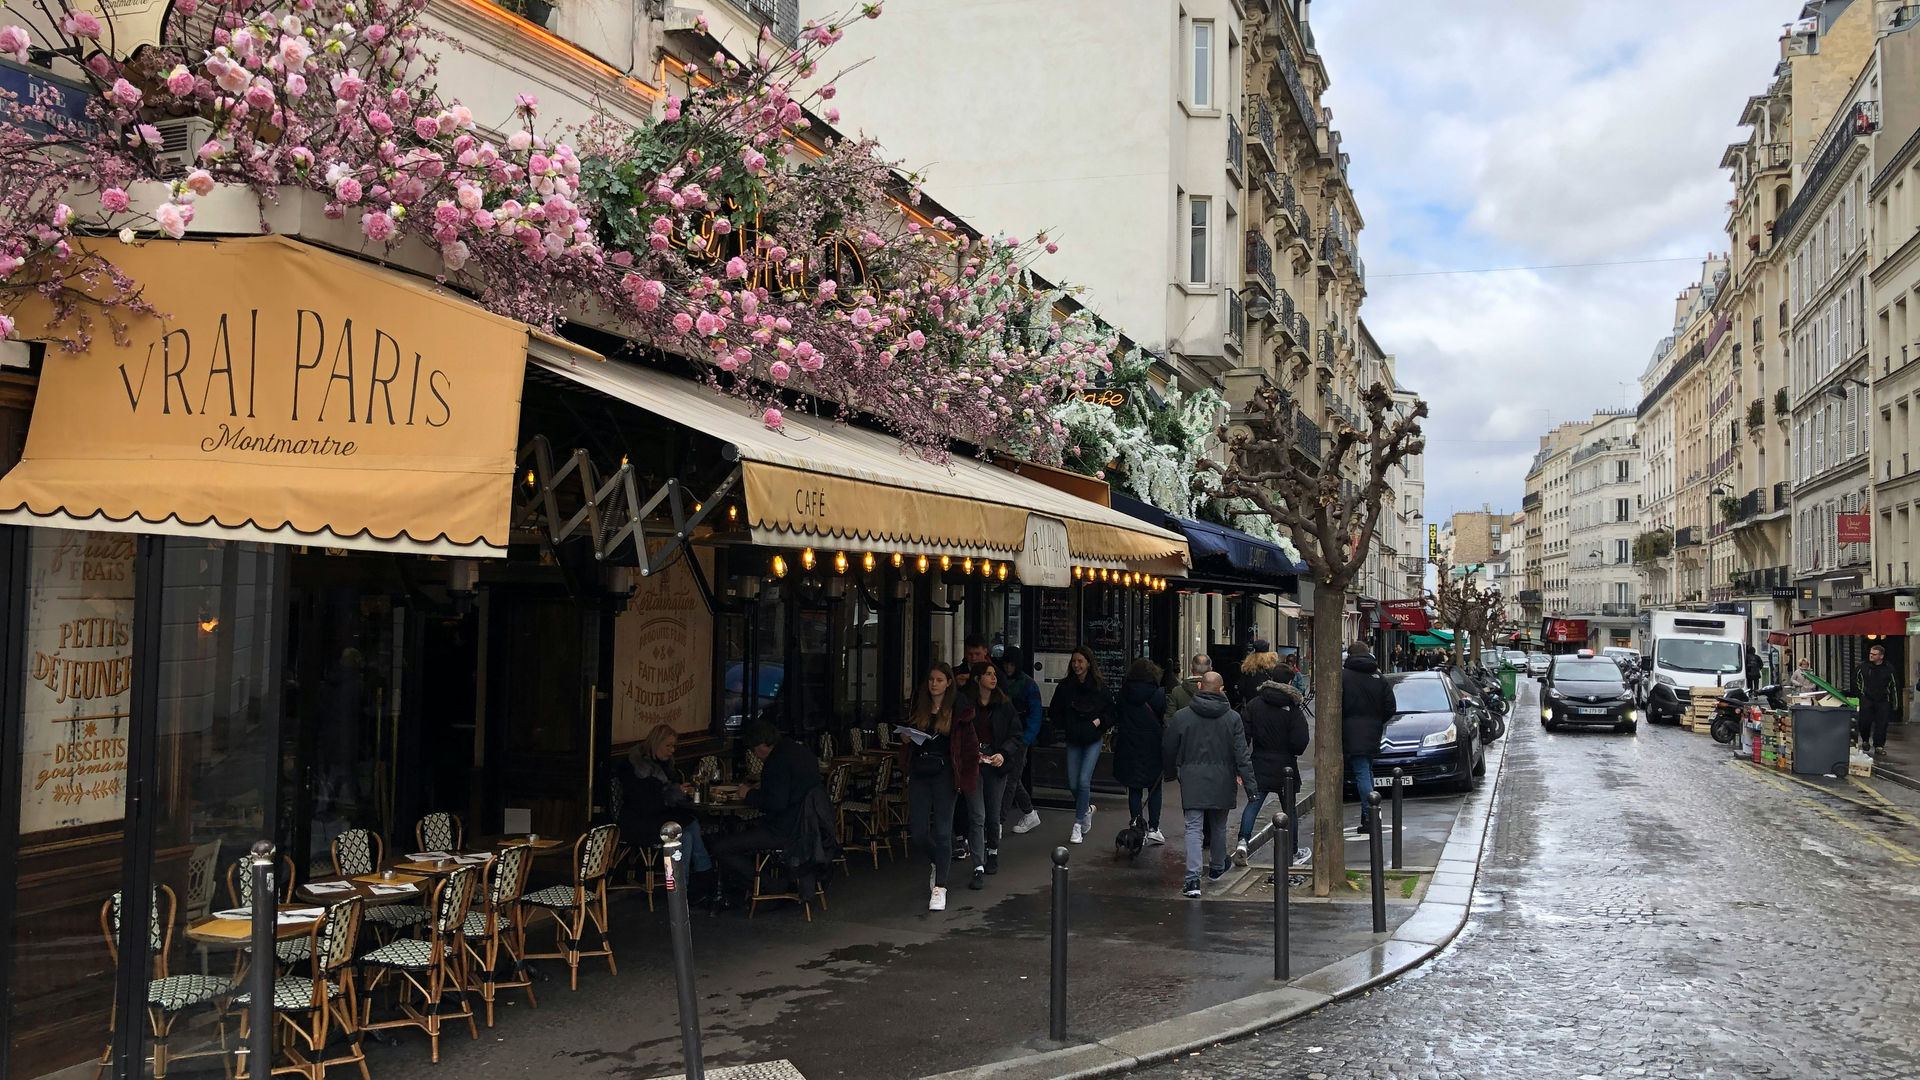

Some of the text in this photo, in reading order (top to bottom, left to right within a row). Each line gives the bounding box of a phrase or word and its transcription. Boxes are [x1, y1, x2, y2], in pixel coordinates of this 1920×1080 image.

[28, 82, 66, 108] RE
[119, 309, 452, 429] VRAI PARIS
[201, 423, 358, 457] Montmartre
[795, 488, 825, 517] CAFÉ
[69, 561, 125, 582] FRAIS
[59, 616, 130, 649] PETITS
[638, 661, 656, 684] FAIT
[635, 686, 665, 707] TOUTE
[55, 737, 126, 764] DESSERTS
[35, 760, 128, 791] gourman
